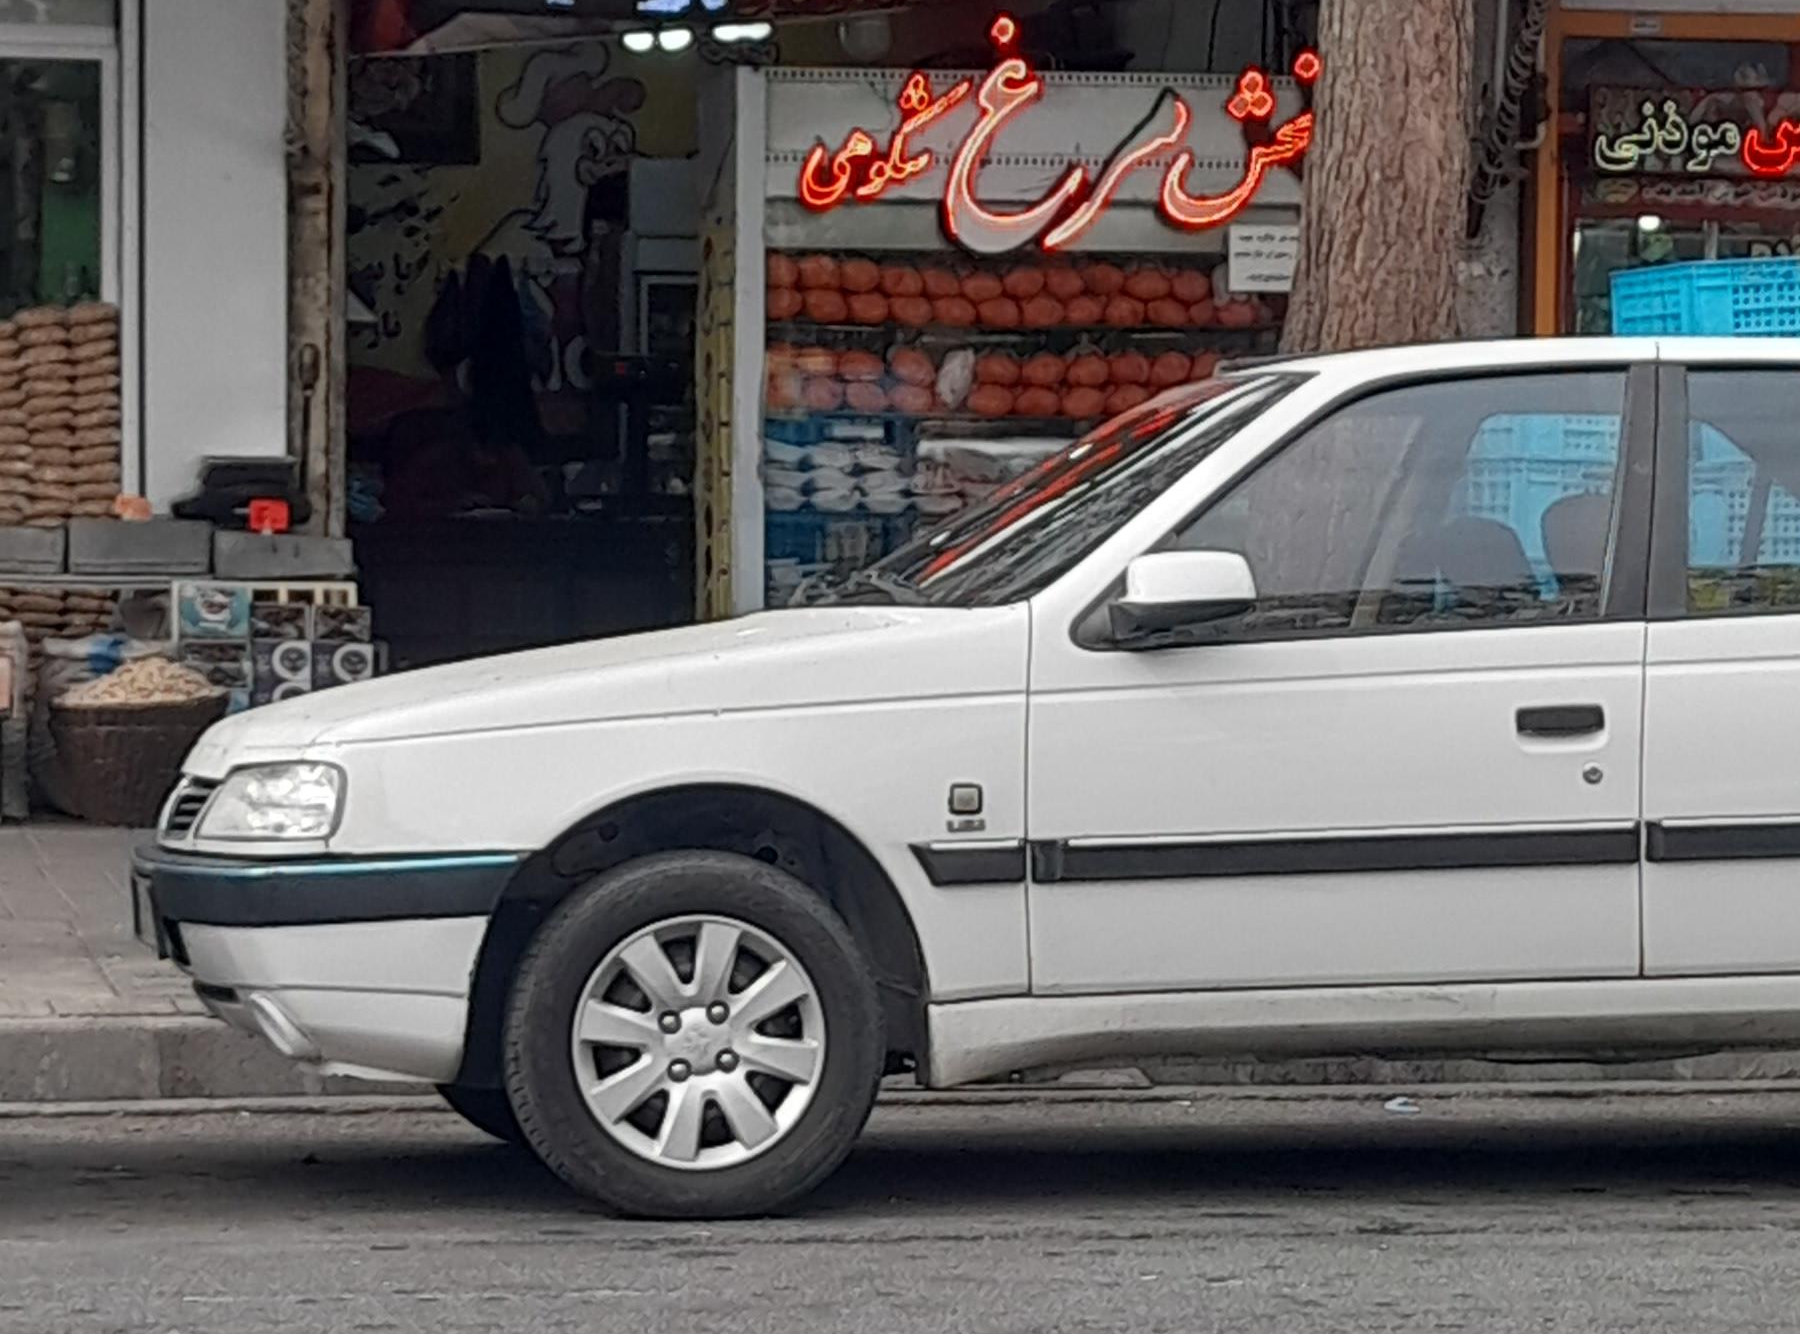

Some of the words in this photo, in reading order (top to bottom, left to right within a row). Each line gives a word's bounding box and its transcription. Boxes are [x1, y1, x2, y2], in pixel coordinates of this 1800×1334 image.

[800, 73, 972, 206] شکوهی
[943, 15, 1187, 253] مرغ
[1595, 100, 1741, 172] موذنی
